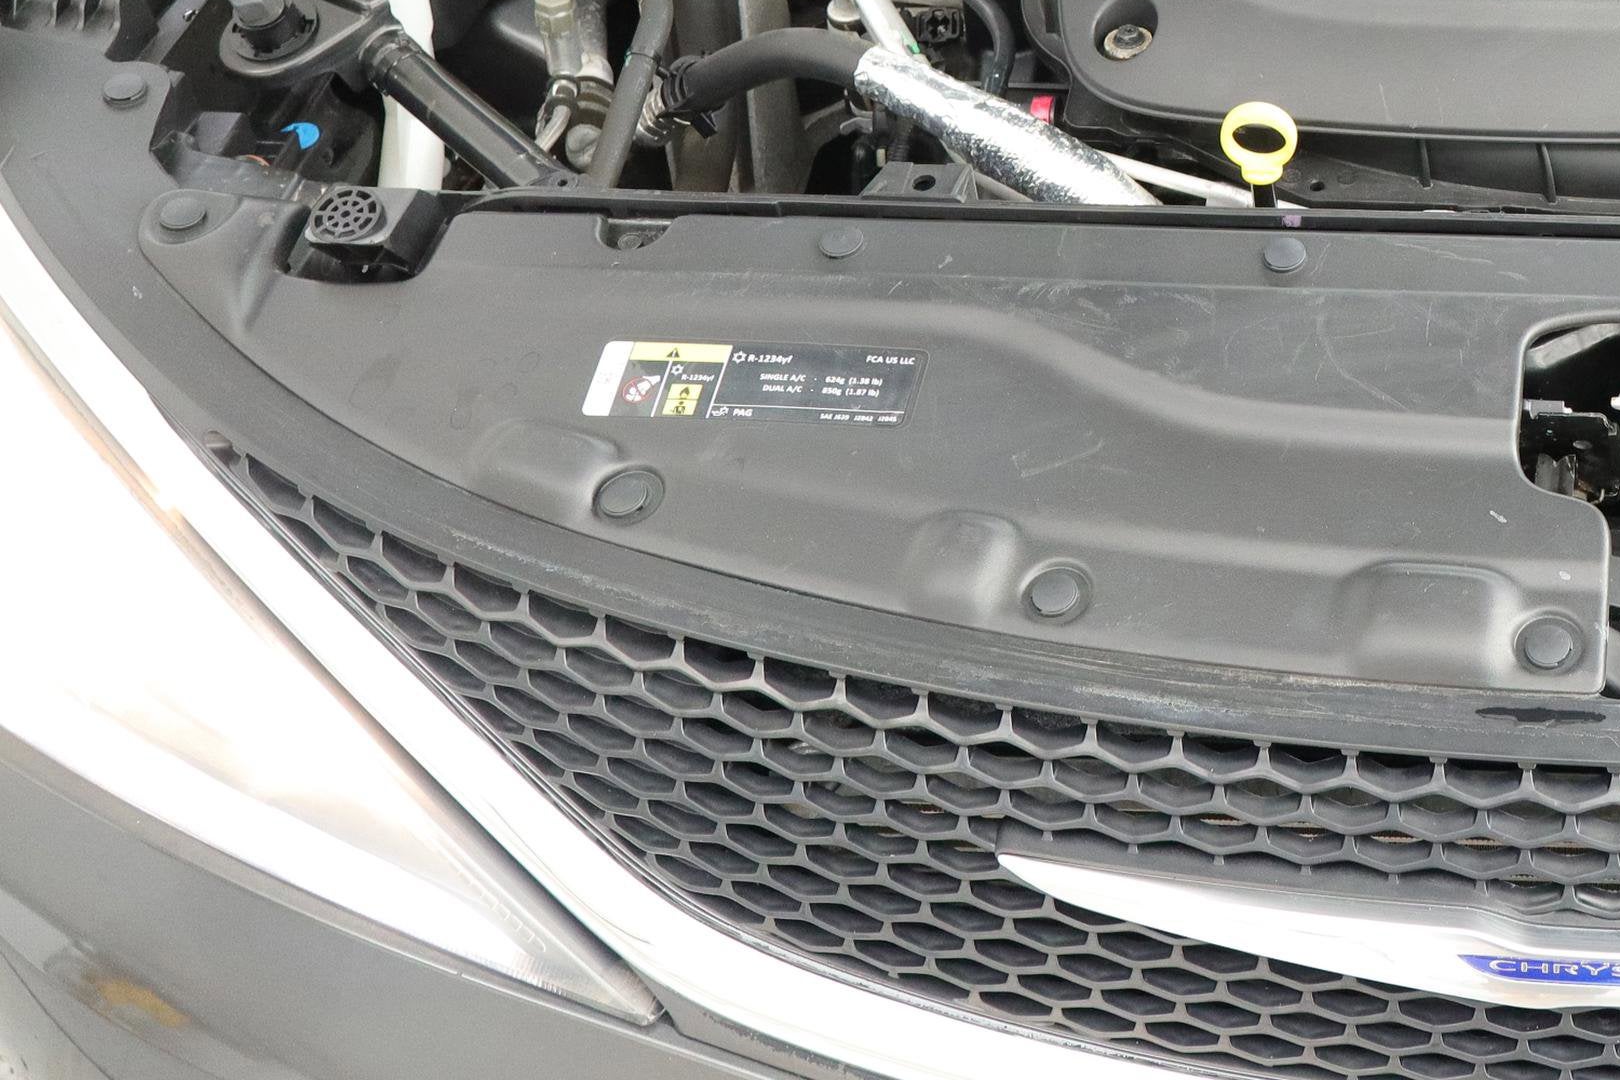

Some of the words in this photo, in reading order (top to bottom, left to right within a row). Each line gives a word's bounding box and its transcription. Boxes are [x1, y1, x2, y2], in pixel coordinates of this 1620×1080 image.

[747, 353, 793, 365] R-1234yf
[865, 355, 884, 363] FCA
[885, 356, 898, 364] US
[899, 357, 916, 365] LLC
[759, 373, 789, 381] SINGLE
[789, 374, 806, 382] A/C
[825, 376, 845, 385] 624g
[871, 378, 883, 387] lb)
[762, 384, 785, 392] DUAL
[785, 385, 803, 393] A/C
[867, 388, 880, 398] lb)
[732, 408, 753, 417] PAG
